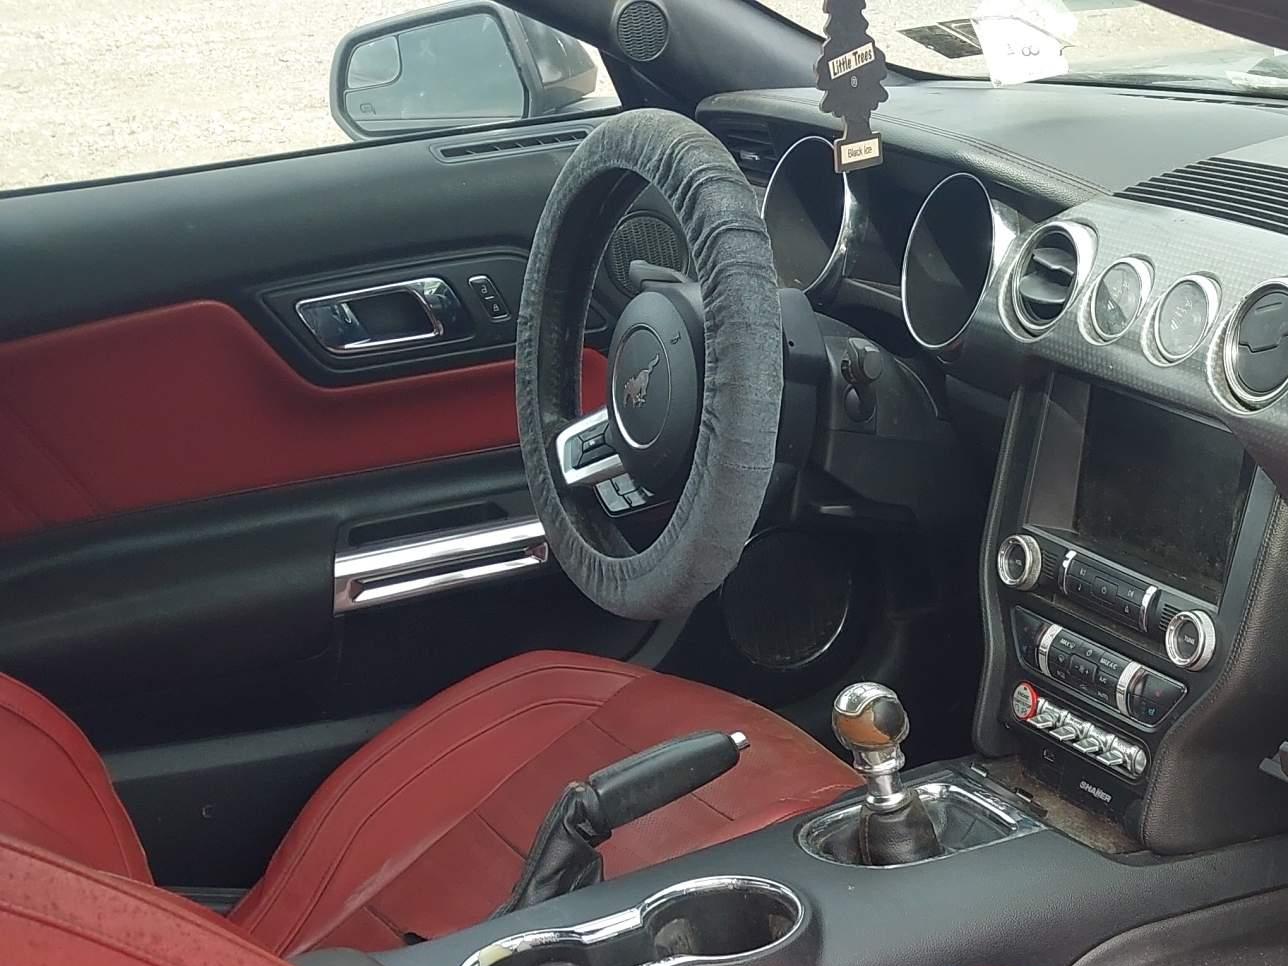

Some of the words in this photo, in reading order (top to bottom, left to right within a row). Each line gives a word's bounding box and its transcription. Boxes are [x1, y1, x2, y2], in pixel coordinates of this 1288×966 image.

[831, 56, 852, 76] Little
[852, 49, 873, 66] Trees
[847, 147, 862, 158] Black
[1080, 780, 1112, 803] SHAKER
